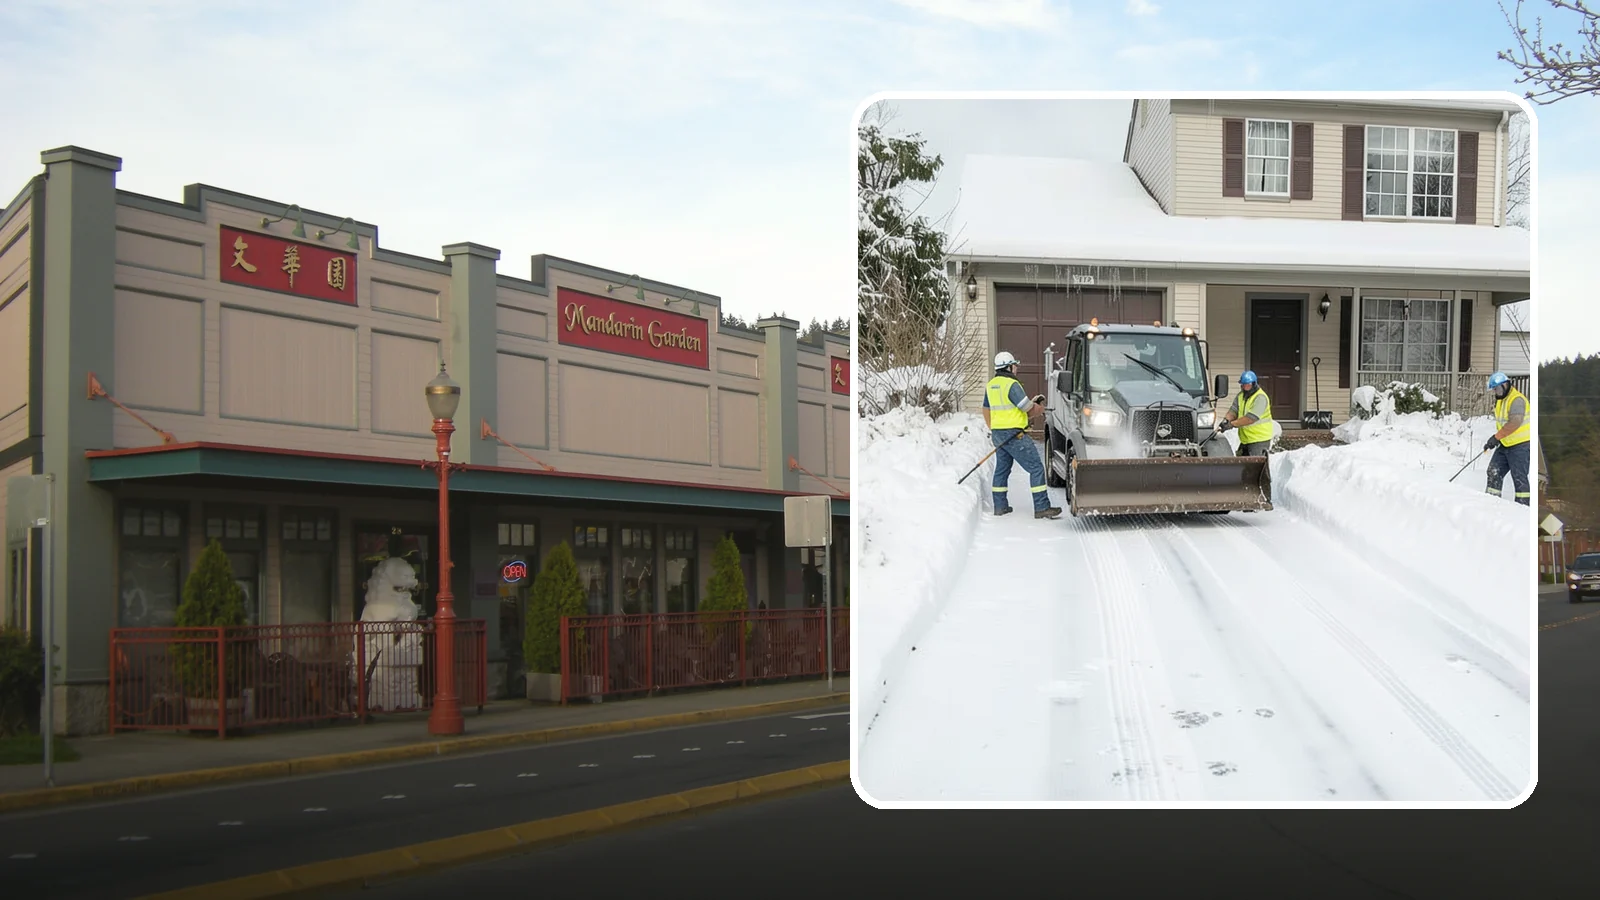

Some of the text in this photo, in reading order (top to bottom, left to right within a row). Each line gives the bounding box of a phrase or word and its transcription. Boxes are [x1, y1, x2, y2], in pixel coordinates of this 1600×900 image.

[564, 302, 702, 352] Mandarin Garden
[503, 565, 526, 578] OPEN
